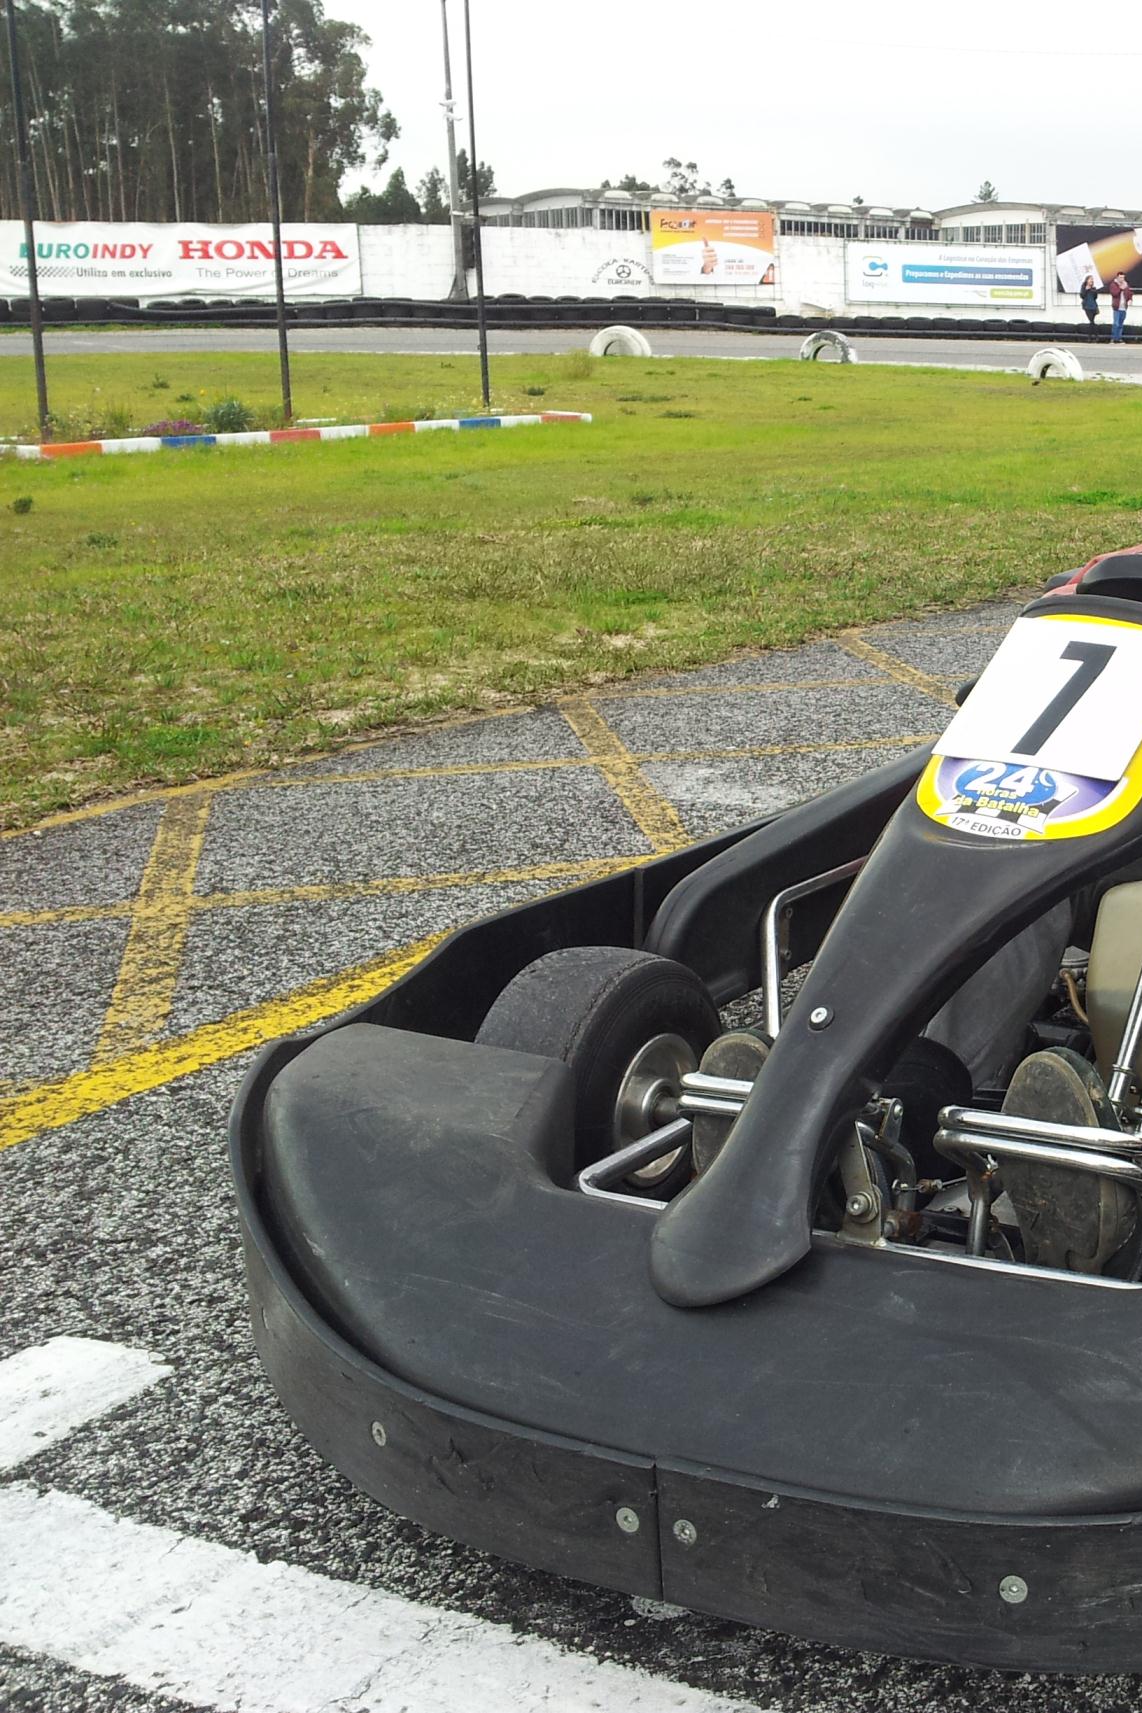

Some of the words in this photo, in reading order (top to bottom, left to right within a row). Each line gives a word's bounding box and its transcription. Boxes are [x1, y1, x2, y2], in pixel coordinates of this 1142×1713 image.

[177, 240, 348, 260] HONDA
[76, 266, 108, 278] Utiliza
[111, 270, 126, 278] em
[129, 266, 173, 278] exclusivo
[196, 267, 221, 278] The
[226, 267, 266, 278] Power
[964, 761, 1039, 797] 24
[954, 794, 973, 806] da
[975, 796, 1040, 817] Batalha
[970, 821, 1022, 837] EDIÇÃO
